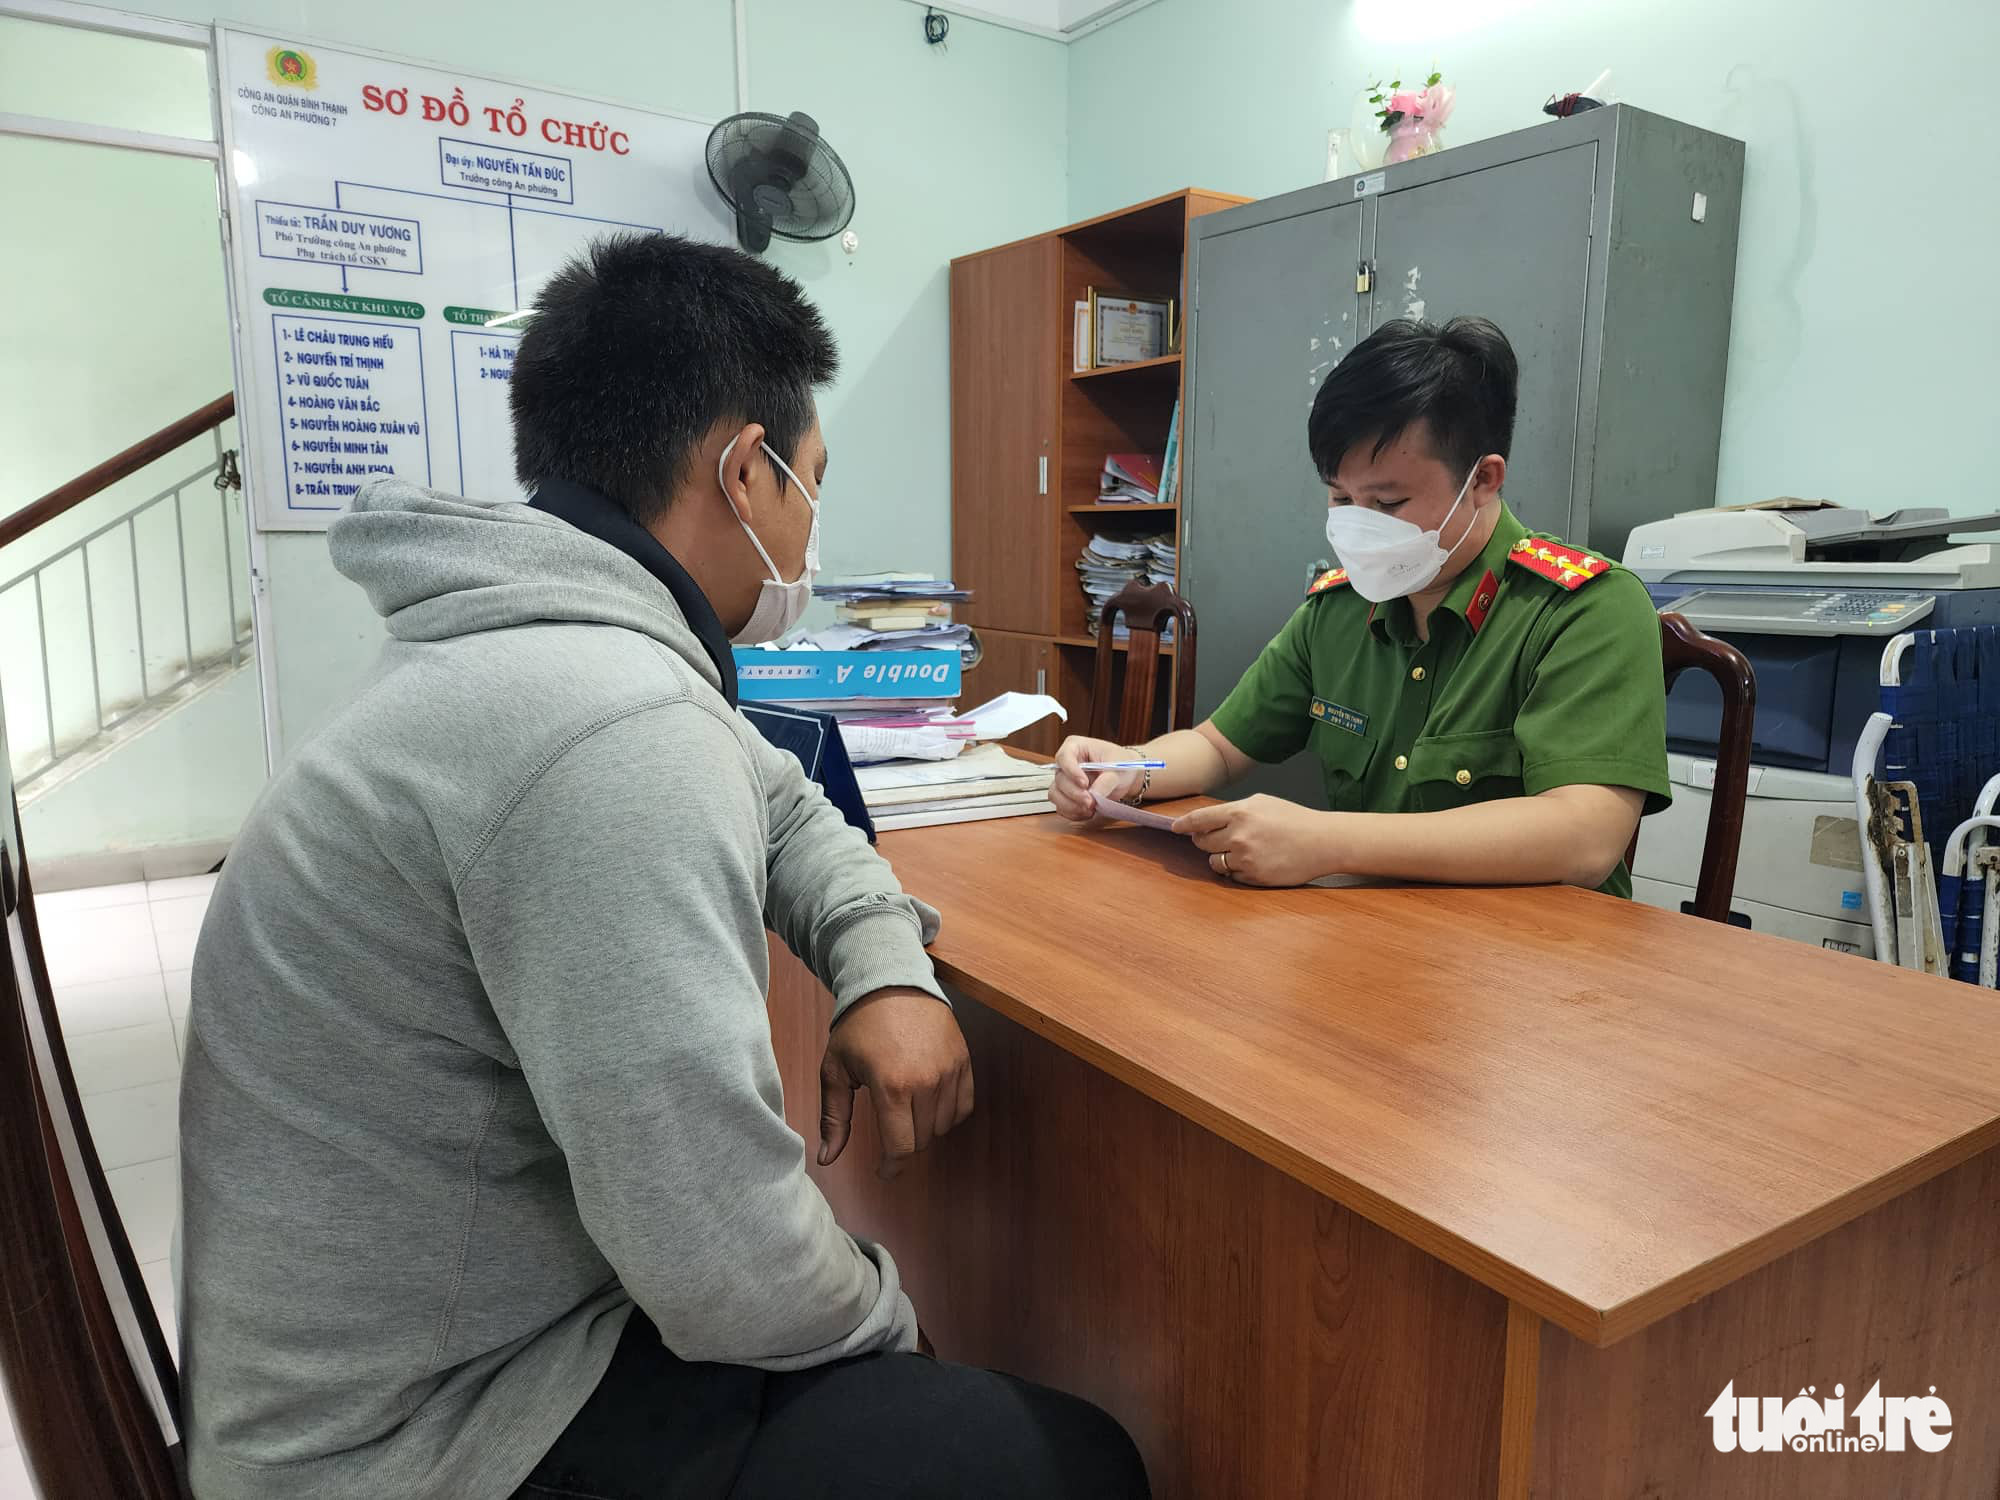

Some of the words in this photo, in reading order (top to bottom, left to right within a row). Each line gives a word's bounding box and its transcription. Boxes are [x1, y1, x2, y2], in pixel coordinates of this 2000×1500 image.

[264, 92, 274, 103] AN
[252, 103, 277, 118] CÔNG
[280, 109, 292, 120] AN
[332, 118, 337, 127] 7
[362, 84, 409, 116] SƠ
[421, 87, 470, 126] ĐỒ
[483, 98, 527, 137] TỔ
[541, 118, 630, 155] CHỨC
[477, 156, 519, 175] NGUYỄN
[515, 181, 526, 190] An
[341, 221, 366, 236] DUY
[369, 223, 412, 241] VƯƠNG
[359, 241, 371, 251] An
[333, 297, 360, 311] SÁT
[361, 302, 390, 314] KHU
[338, 333, 371, 348] TRUNG
[313, 371, 342, 389] QUỐC
[299, 394, 335, 410] HOÀNG
[342, 418, 377, 433] HOÀNG
[344, 442, 368, 455] MINH
[346, 464, 366, 475] ANH
[747, 668, 821, 677] EVERYDAY
[836, 664, 854, 684] A
[863, 664, 950, 683] Double
